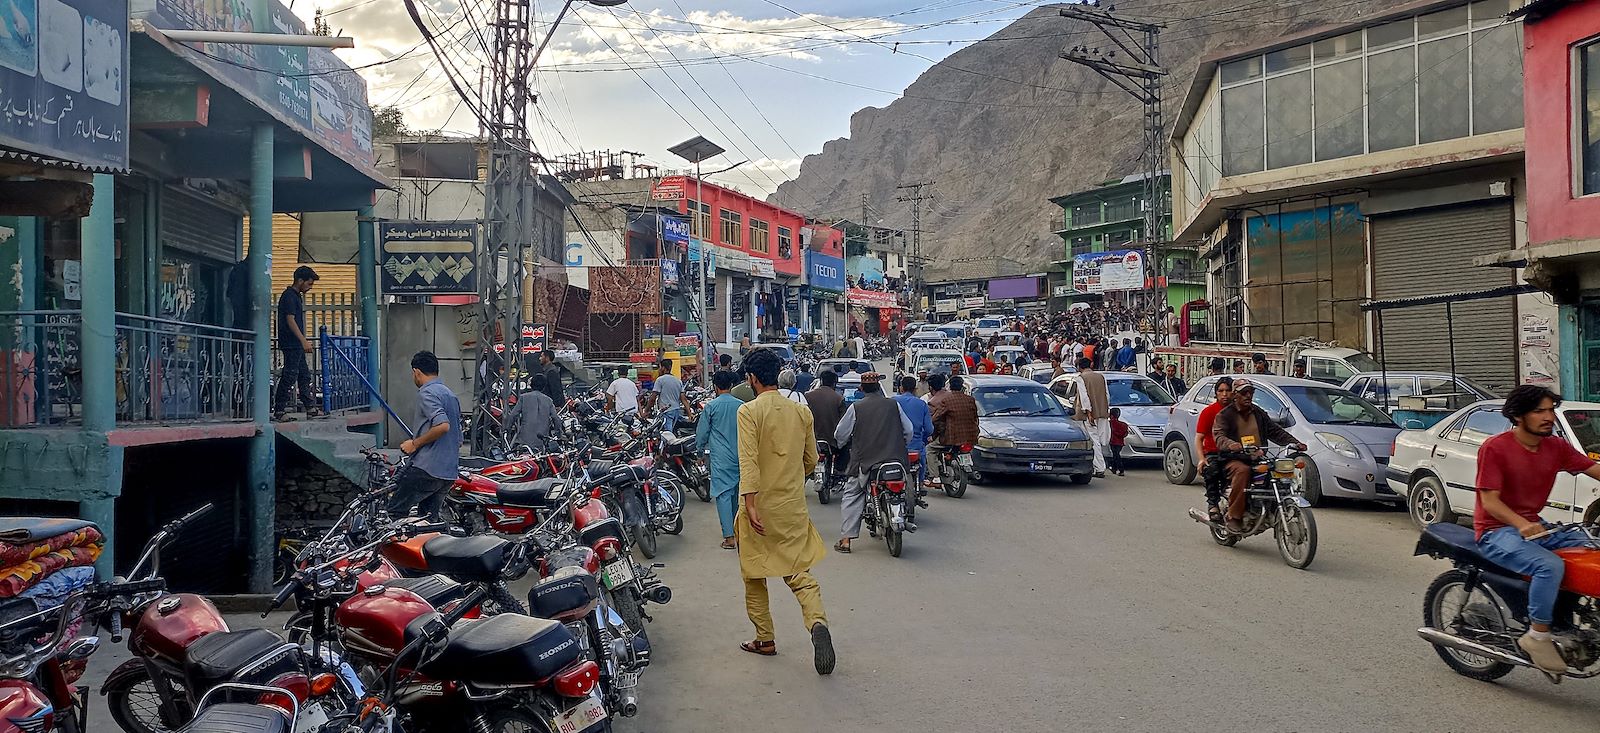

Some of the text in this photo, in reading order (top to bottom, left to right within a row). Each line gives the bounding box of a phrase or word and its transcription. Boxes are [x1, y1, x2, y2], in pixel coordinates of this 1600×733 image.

[12, 97, 41, 127] نایاب
[41, 96, 56, 125] کے
[57, 94, 73, 139] قسم
[814, 263, 837, 279] TECNO
[539, 638, 574, 661] HONDA
